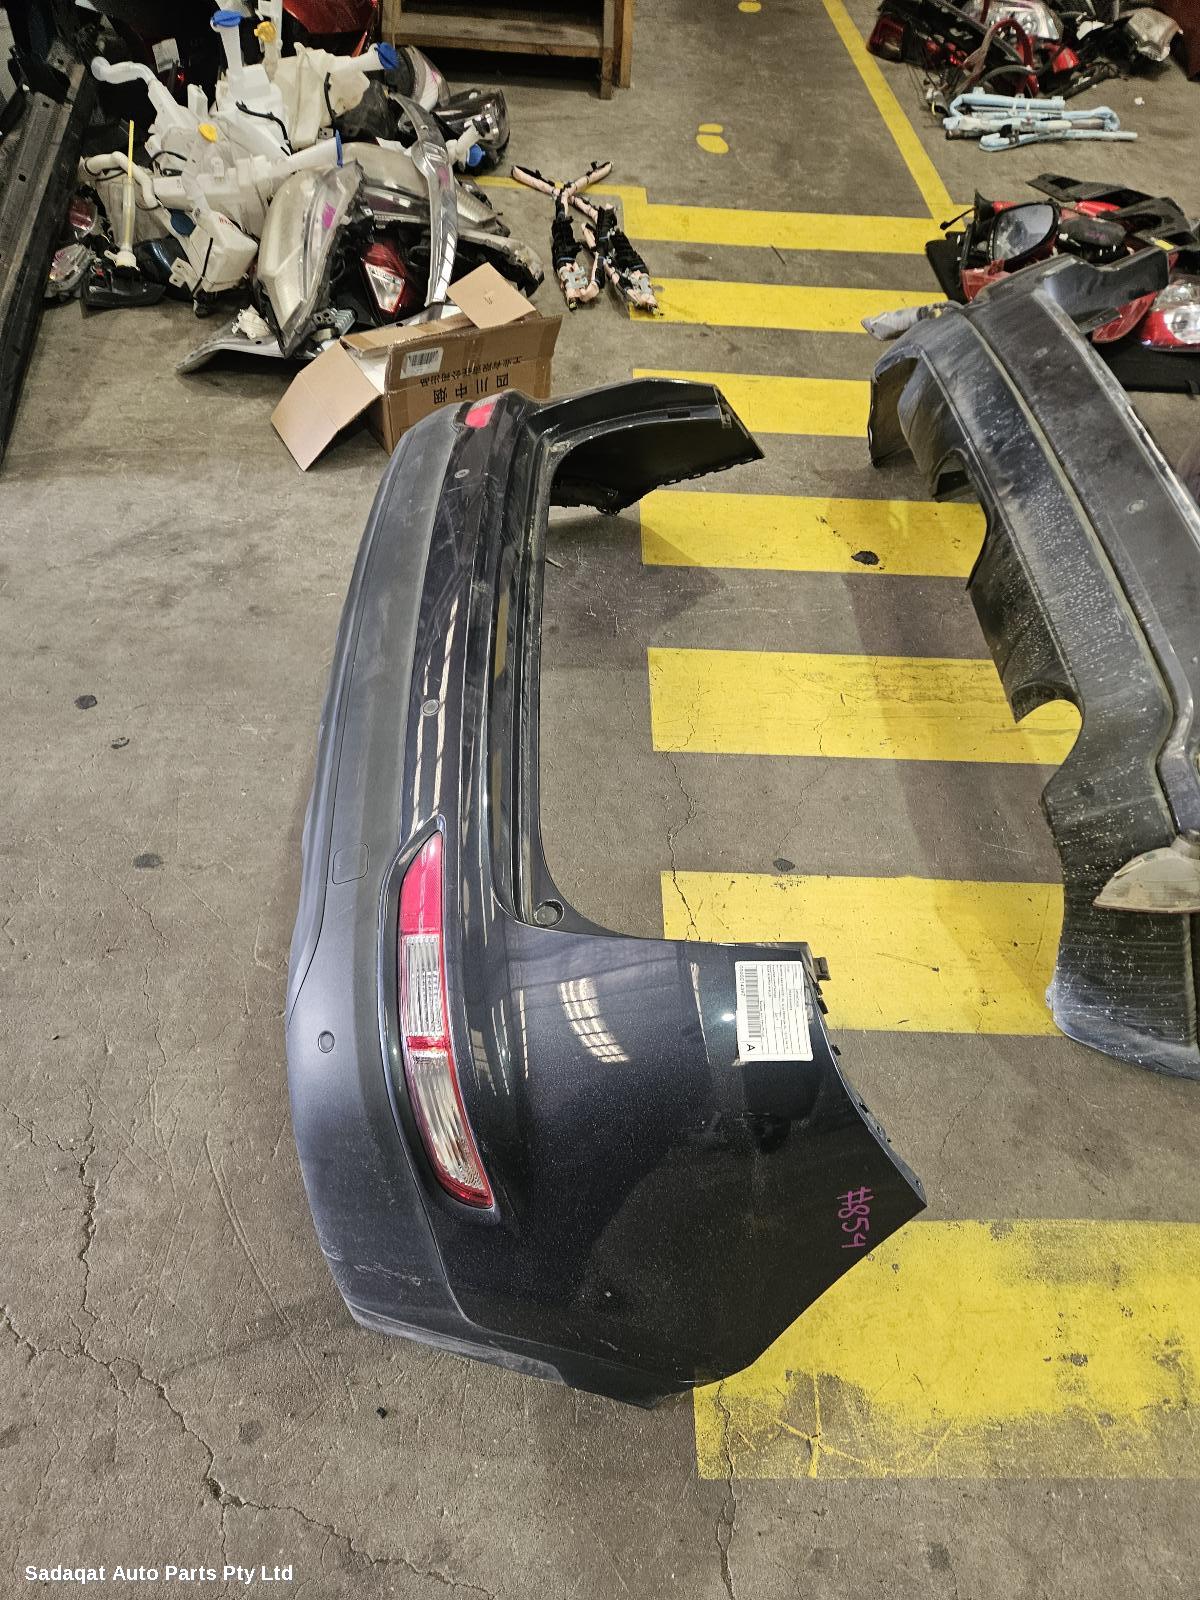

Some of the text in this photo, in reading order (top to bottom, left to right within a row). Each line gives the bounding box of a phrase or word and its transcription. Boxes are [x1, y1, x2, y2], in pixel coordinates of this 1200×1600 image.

[433, 373, 509, 405] 四川中烟
[746, 1043, 756, 1052] A
[836, 1186, 874, 1248] #854
